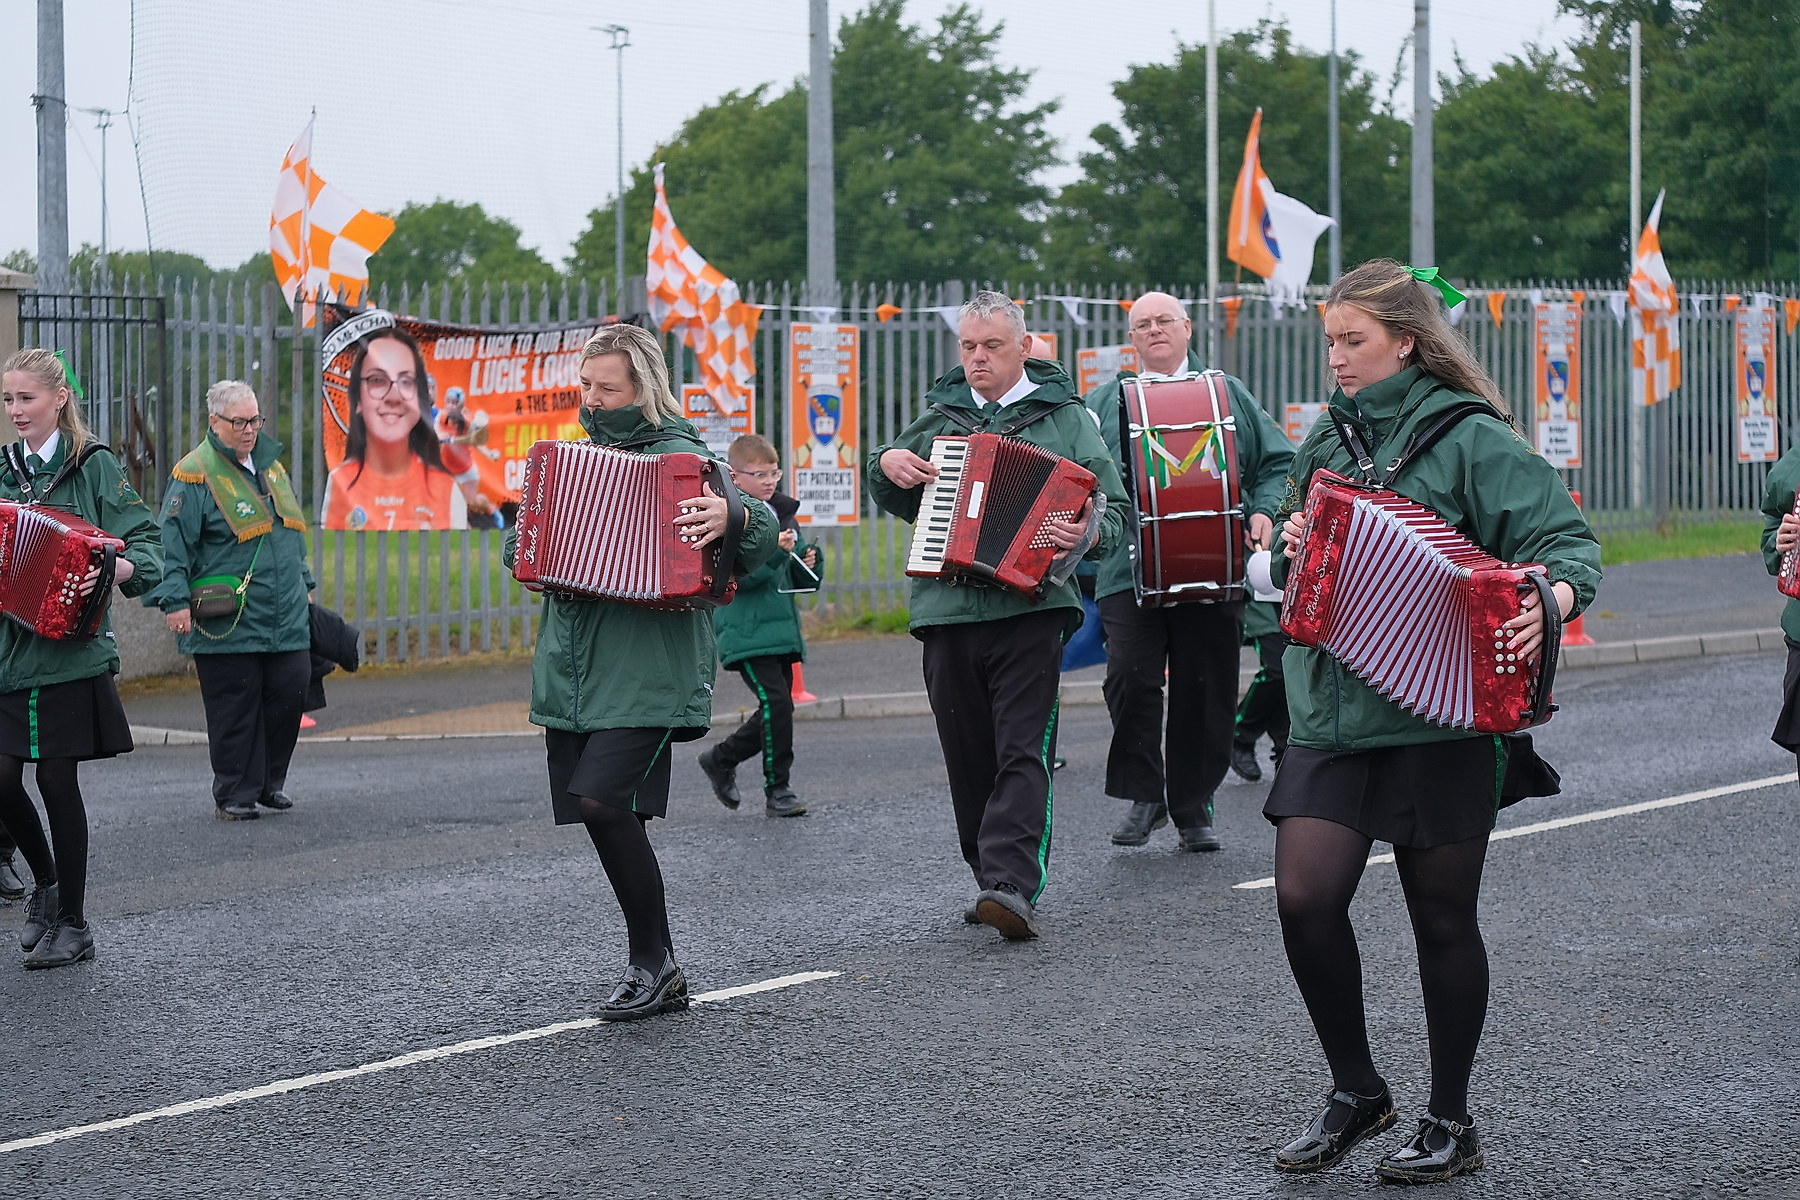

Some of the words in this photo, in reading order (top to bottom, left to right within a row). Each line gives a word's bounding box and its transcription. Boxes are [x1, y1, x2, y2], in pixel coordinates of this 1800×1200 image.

[433, 336, 475, 361] GOOD
[477, 334, 515, 359] LUCK
[514, 333, 533, 356] TO
[533, 331, 562, 354] OUR
[469, 356, 530, 396] LUCIE
[526, 394, 549, 412] THE
[551, 389, 582, 411] ARM
[530, 453, 548, 516] Soprani
[798, 471, 808, 486] ST
[810, 471, 853, 486] PATRICK'S
[799, 489, 831, 501] CAMOGIE
[524, 524, 539, 565] Paolo
[1305, 582, 1322, 622] Paolo
[1315, 517, 1339, 579] Soprani
